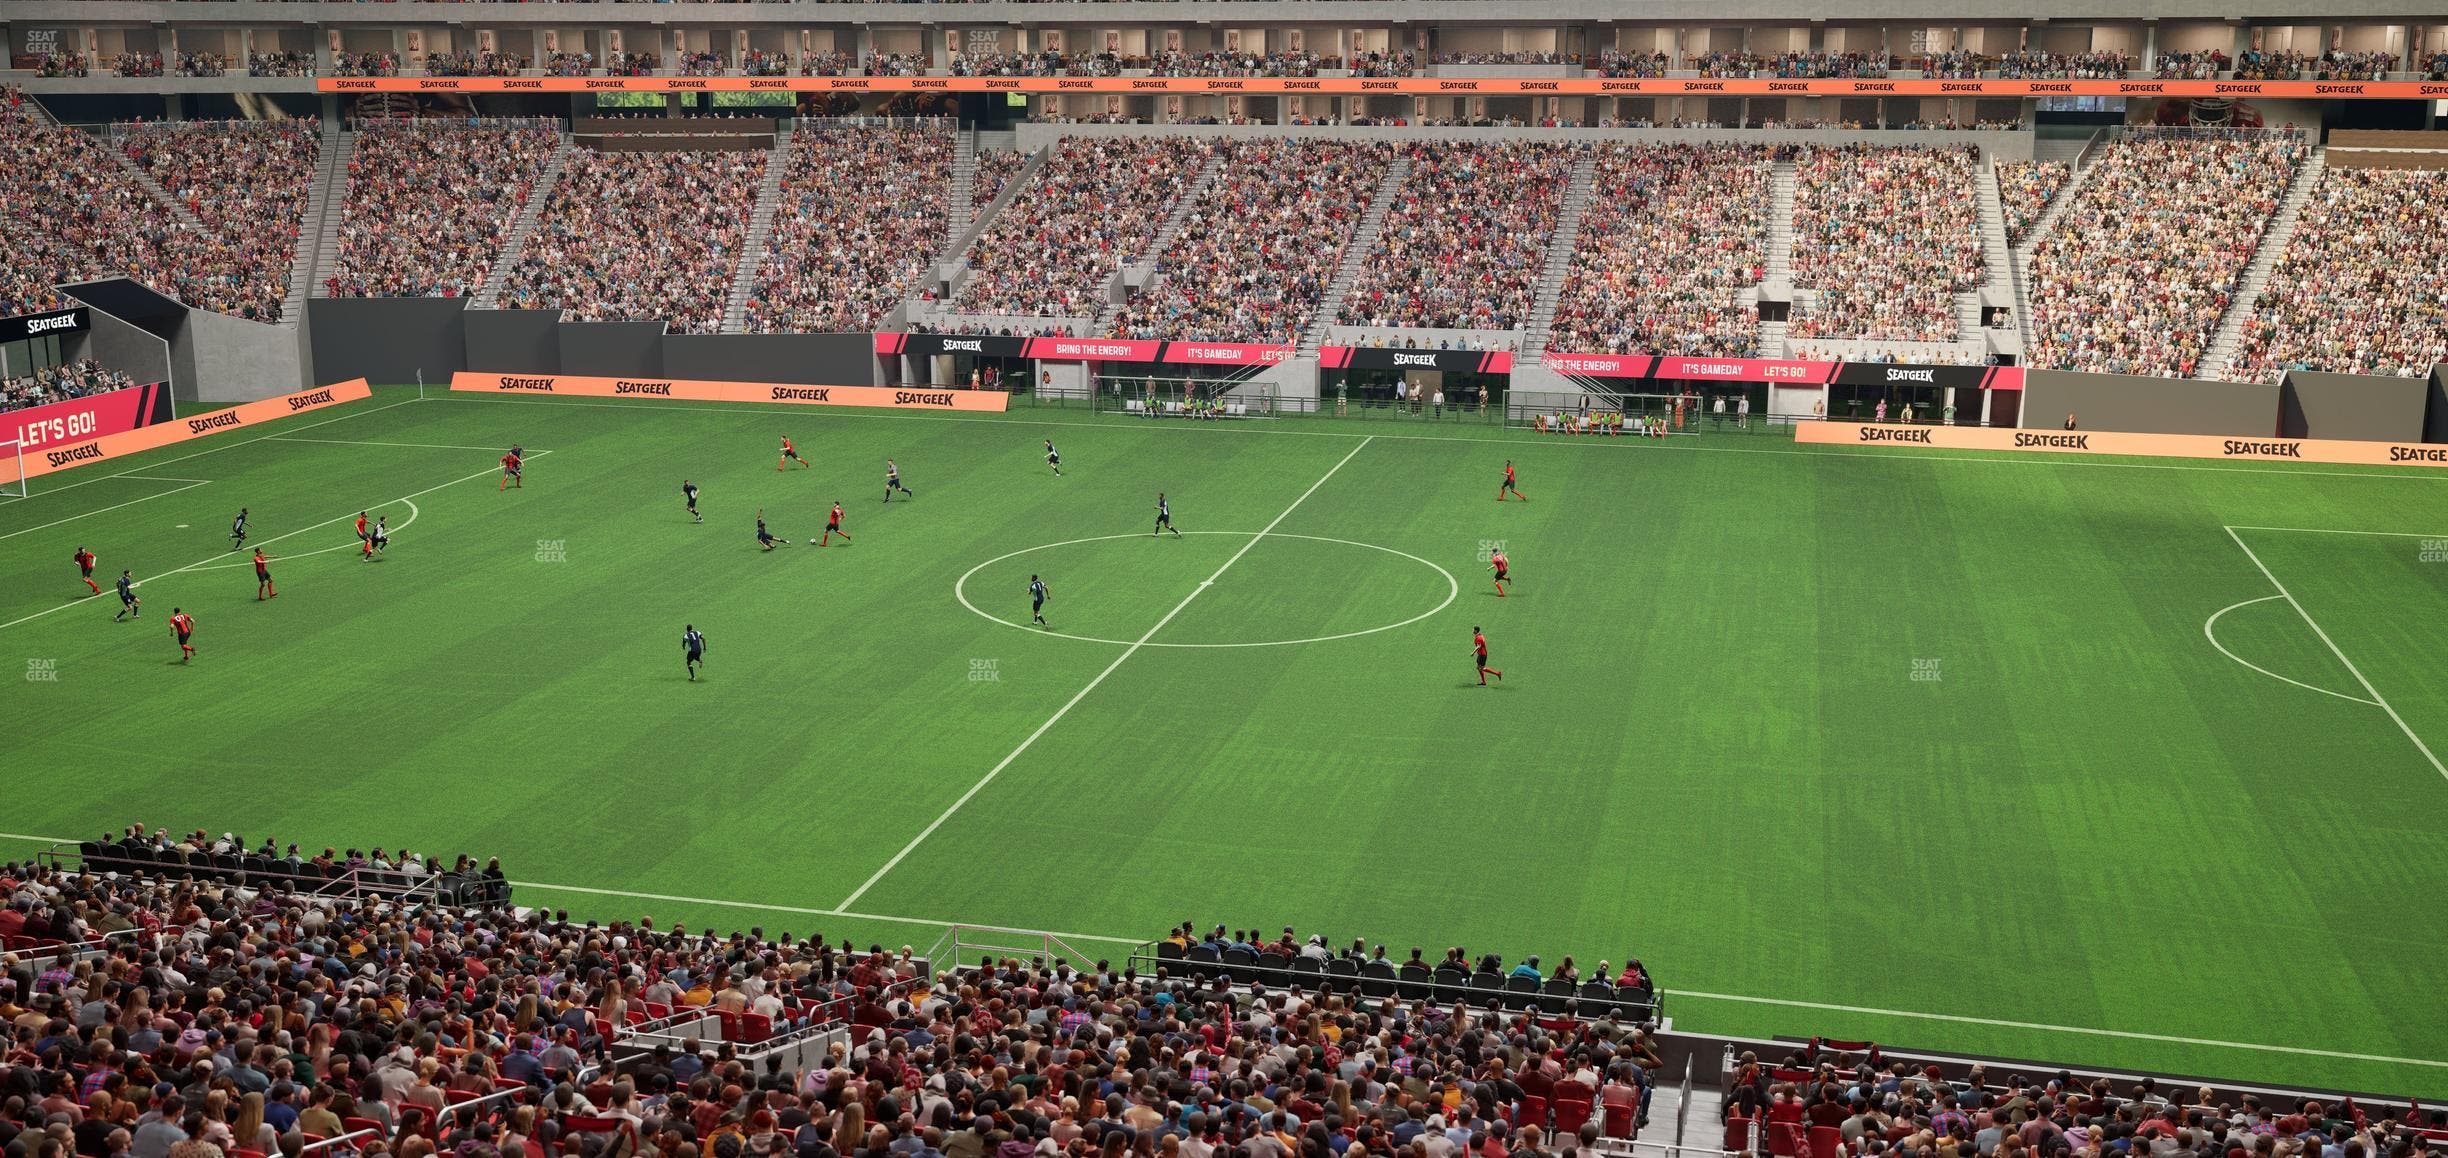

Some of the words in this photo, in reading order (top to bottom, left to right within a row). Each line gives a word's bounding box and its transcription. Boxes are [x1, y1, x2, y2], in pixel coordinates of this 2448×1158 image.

[336, 80, 377, 89] SEATGEEK
[420, 80, 460, 89] SEATGEEK
[503, 80, 543, 89] SEATGEEK
[585, 80, 625, 89] SEATGEEK
[667, 80, 707, 89] SEATGEEK
[749, 80, 789, 89] SEATGEEK
[831, 79, 870, 89] SEATGEEK
[911, 79, 948, 88] SEATGEEK
[985, 80, 1020, 89] SEATGEEK
[1058, 80, 1094, 89] SEATGEEK
[1132, 80, 1168, 89] SEATGEEK
[1207, 80, 1244, 89] SEATGEEK
[1283, 80, 1321, 90] SEATGEEK
[1361, 81, 1399, 90] SEATGEEK
[1440, 81, 1478, 90] SEATGEEK
[1520, 81, 1558, 91] SEATGEEK
[1601, 82, 1641, 91] SEATGEEK
[1684, 82, 1724, 91] SEATGEEK
[1768, 82, 1809, 91] SEATGEEK
[1854, 82, 1895, 92] SEATGEEK
[1941, 82, 1983, 92] SEATGEEK
[2029, 83, 2072, 93] SEATGEEK
[2119, 83, 2164, 93] SEATGEEK
[2215, 83, 2262, 94] SEATGEEK
[2315, 84, 2364, 95] SEATGEEK
[27, 313, 77, 334] SEATGEEK
[943, 338, 982, 352] SEATGEEK
[1056, 343, 1081, 355] BRING
[1082, 344, 1097, 355] THE
[1098, 345, 1132, 356] ENERGY!
[1187, 348, 1203, 358] IT'S
[1204, 348, 1243, 359] GAMEDAY
[1393, 352, 1437, 367] SEATGEEK
[1564, 360, 1582, 370] THE
[1583, 360, 1620, 372] ENERGY!
[1682, 363, 1699, 374] IT'S
[1700, 364, 1744, 376] GAMEDAY
[1764, 366, 1788, 377] LET'S
[1790, 367, 1807, 378] GO!
[1886, 368, 1934, 383] SEATGEEK
[499, 377, 555, 392] SEATGEEK
[615, 381, 672, 396] SEATGEEK
[771, 386, 830, 402] SEATGEEK
[894, 391, 955, 407] SEATGEEK
[18, 417, 65, 448] LET'S
[67, 411, 96, 437] GO!
[46, 442, 104, 468] SEATGEEK
[188, 410, 241, 435] SEATGEEK
[287, 388, 336, 411] SEATGEEK
[1859, 426, 1932, 444] SEATGEEK
[2014, 432, 2089, 450] SEATGEEK
[2223, 440, 2301, 458] SEATGEEK
[2389, 446, 2448, 462] SEATGE
